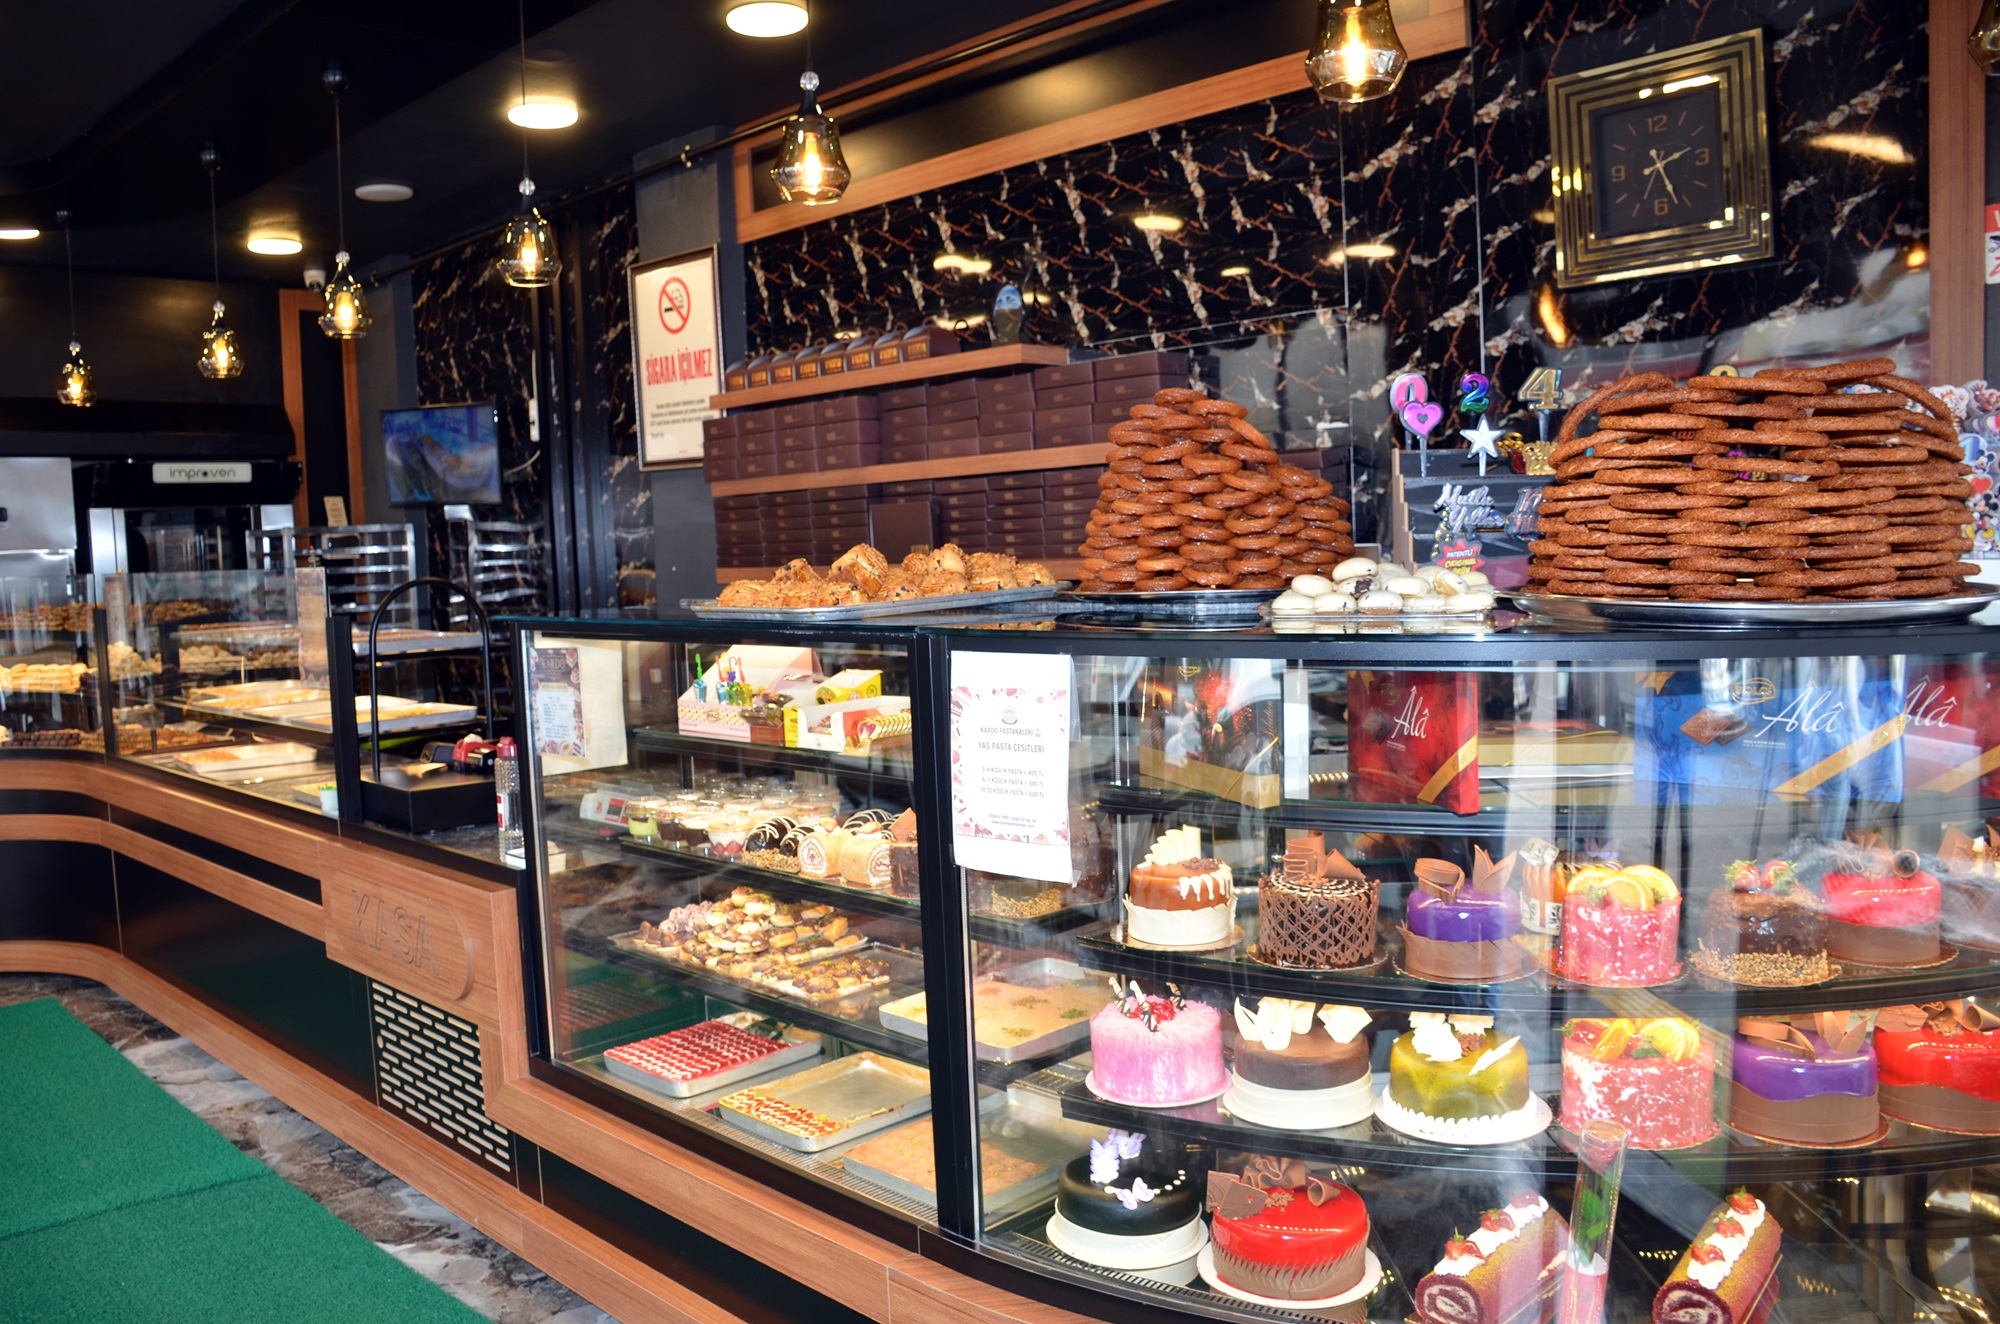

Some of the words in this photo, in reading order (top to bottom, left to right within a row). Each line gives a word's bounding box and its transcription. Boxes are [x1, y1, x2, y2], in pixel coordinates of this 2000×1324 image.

[1647, 114, 1667, 133] 12
[1695, 148, 1709, 166] 3
[1611, 165, 1625, 182] 9
[1654, 198, 1668, 215] 6
[645, 354, 677, 386] SİGARA
[677, 347, 712, 384] İÇİLMEZ
[1460, 373, 1490, 412] 2
[978, 741, 990, 750] YAŞ
[991, 742, 1012, 751] PASTA
[352, 890, 440, 976] KASA
